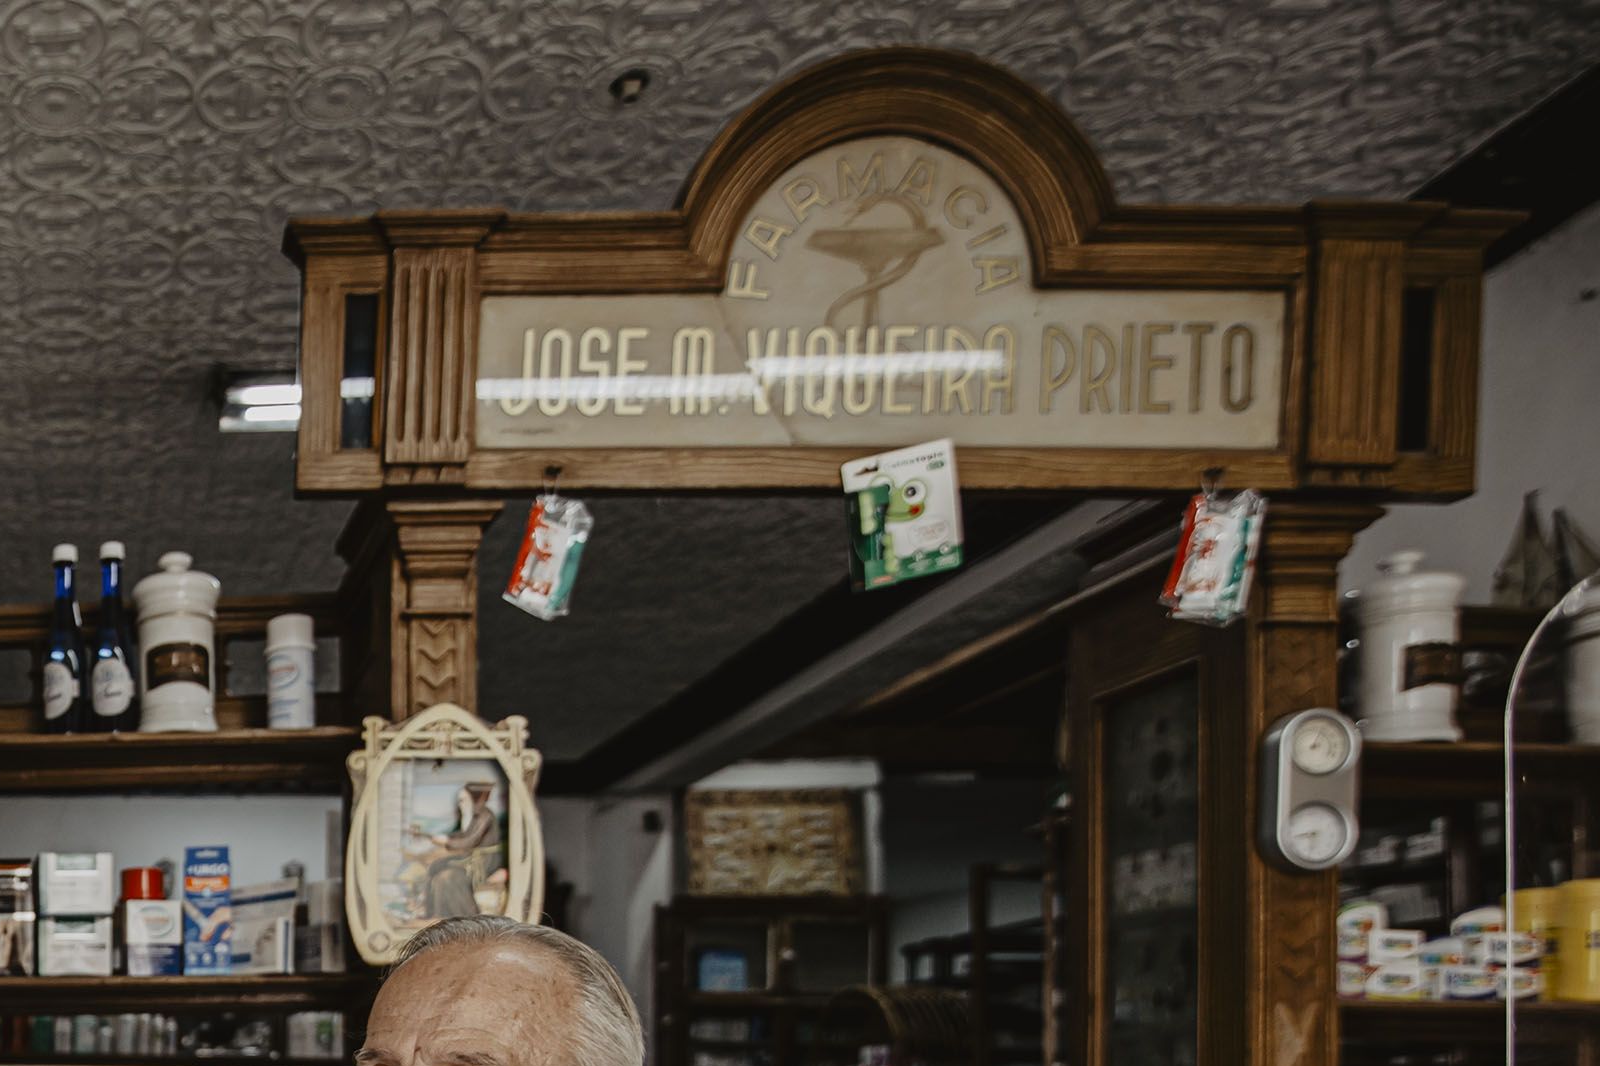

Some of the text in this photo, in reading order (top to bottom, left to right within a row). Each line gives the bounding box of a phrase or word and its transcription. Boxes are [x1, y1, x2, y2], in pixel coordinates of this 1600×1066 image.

[726, 151, 1021, 300] FARMACIA
[499, 322, 1254, 419] JOSE M. VIQUEIRA PRIETO
